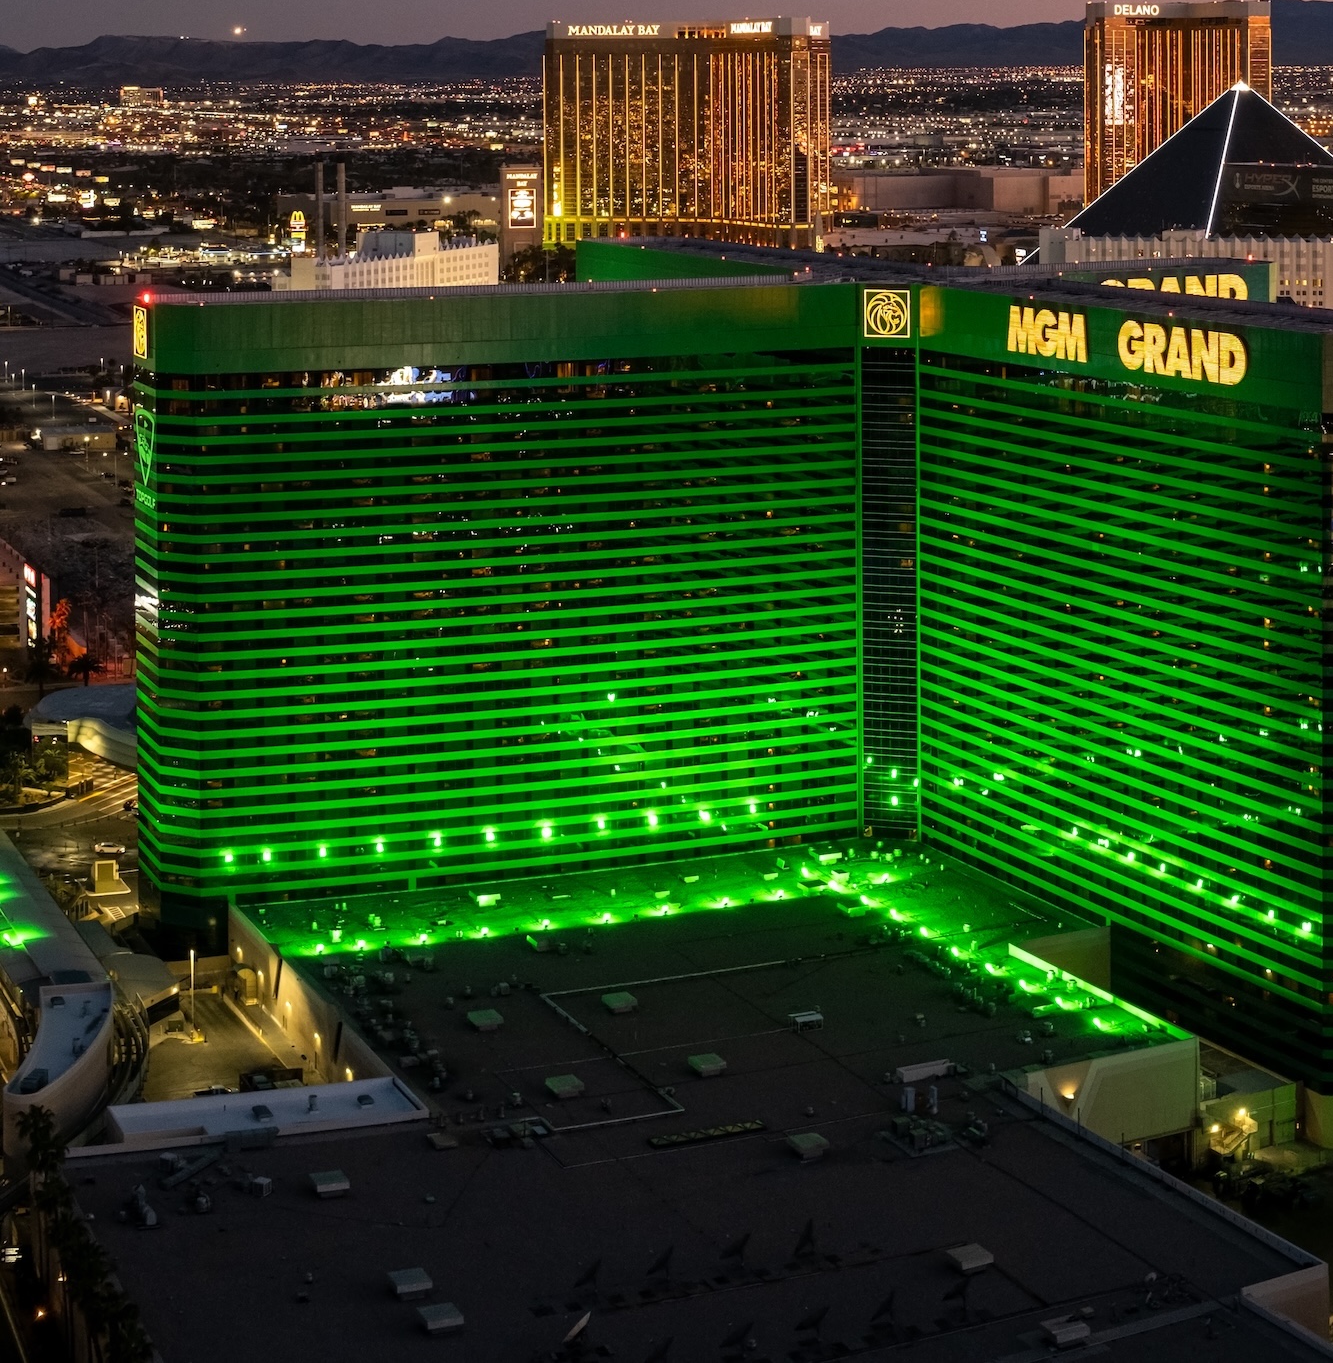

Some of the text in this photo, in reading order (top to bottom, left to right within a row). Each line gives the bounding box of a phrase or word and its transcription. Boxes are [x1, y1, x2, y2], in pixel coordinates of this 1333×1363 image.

[1114, 4, 1159, 15] DELANO
[568, 25, 660, 36] MANDALAY BAY
[1007, 305, 1248, 386] MGM GRAND
